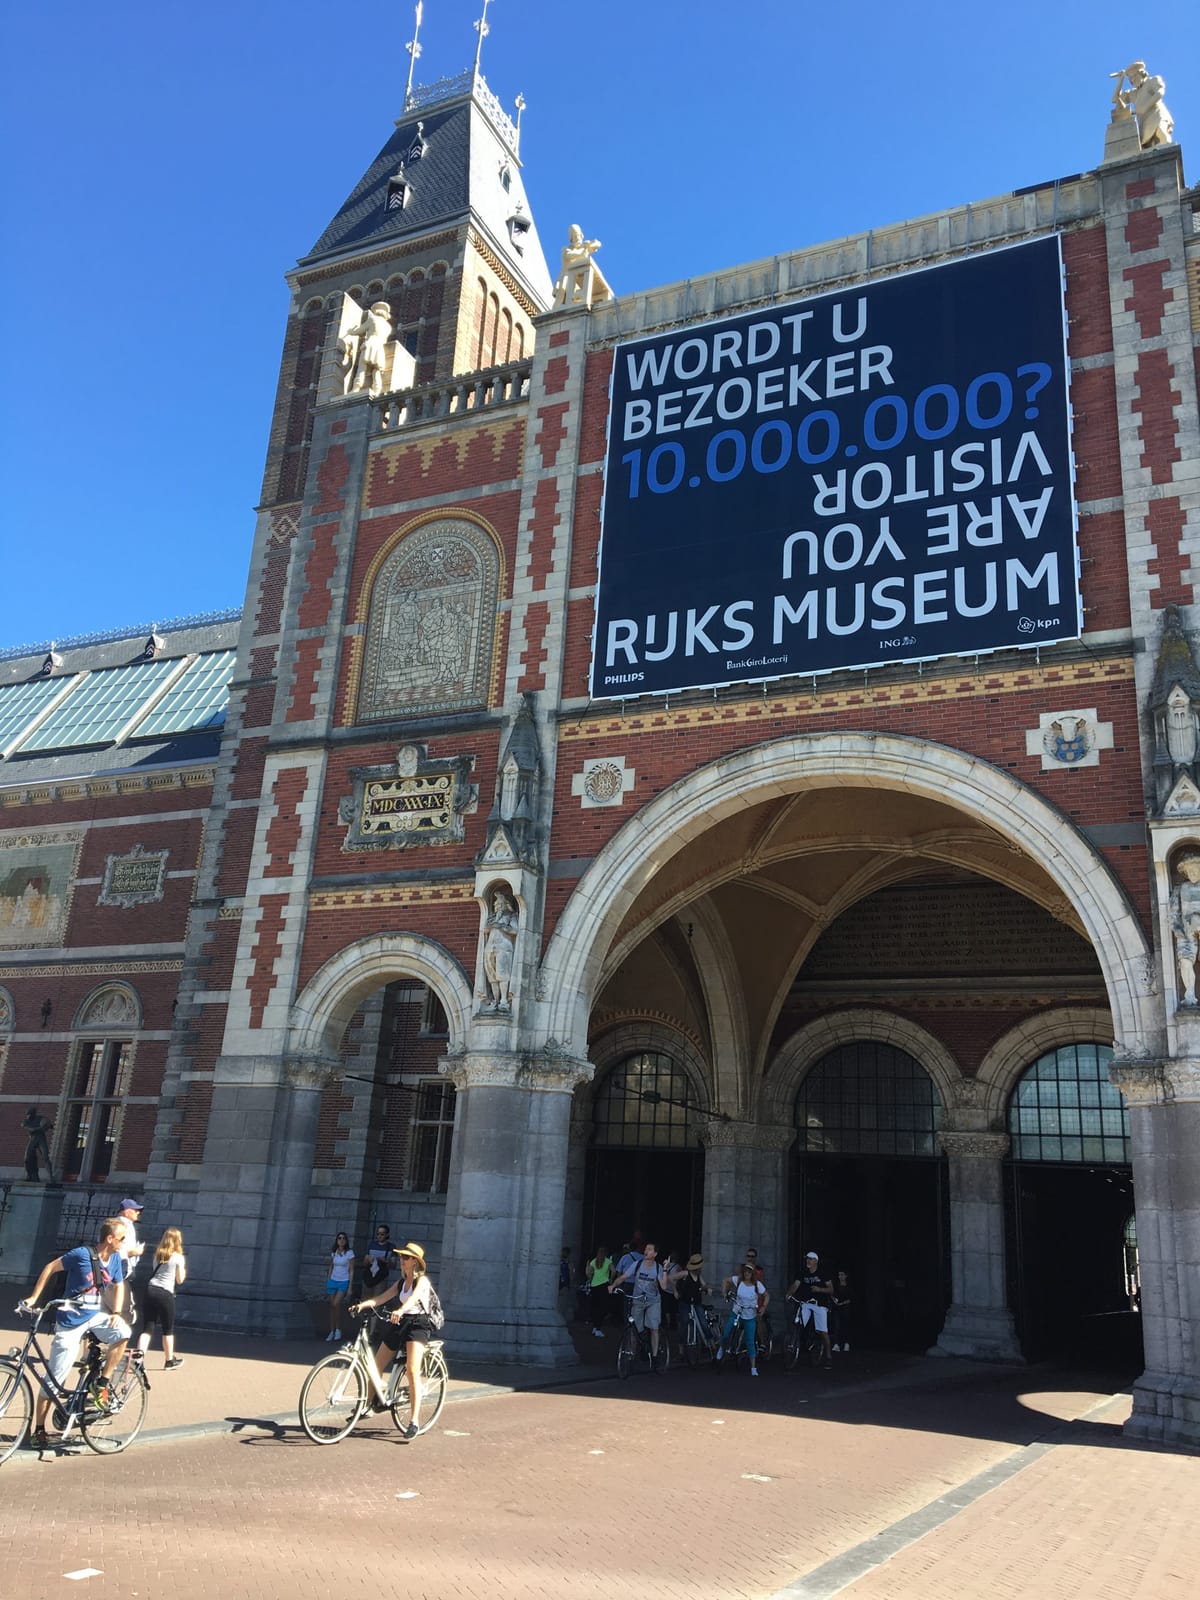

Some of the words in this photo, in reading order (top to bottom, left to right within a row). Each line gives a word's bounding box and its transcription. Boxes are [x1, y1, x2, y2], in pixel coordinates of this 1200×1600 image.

[627, 310, 814, 391] WORDT
[832, 297, 867, 343] U
[623, 344, 895, 441] BEZOEKER
[621, 362, 1053, 499] 10.000.000?
[812, 430, 1053, 516] VISITOR
[782, 516, 906, 580] YOU
[927, 486, 1054, 556] ARE
[605, 600, 755, 667] RIJKS
[772, 551, 1060, 645] MUSEUM
[879, 638, 901, 649] ING
[1037, 618, 1060, 629] kpn
[604, 671, 645, 685] PHILIPS
[726, 654, 788, 670] BankGiroLoterij
